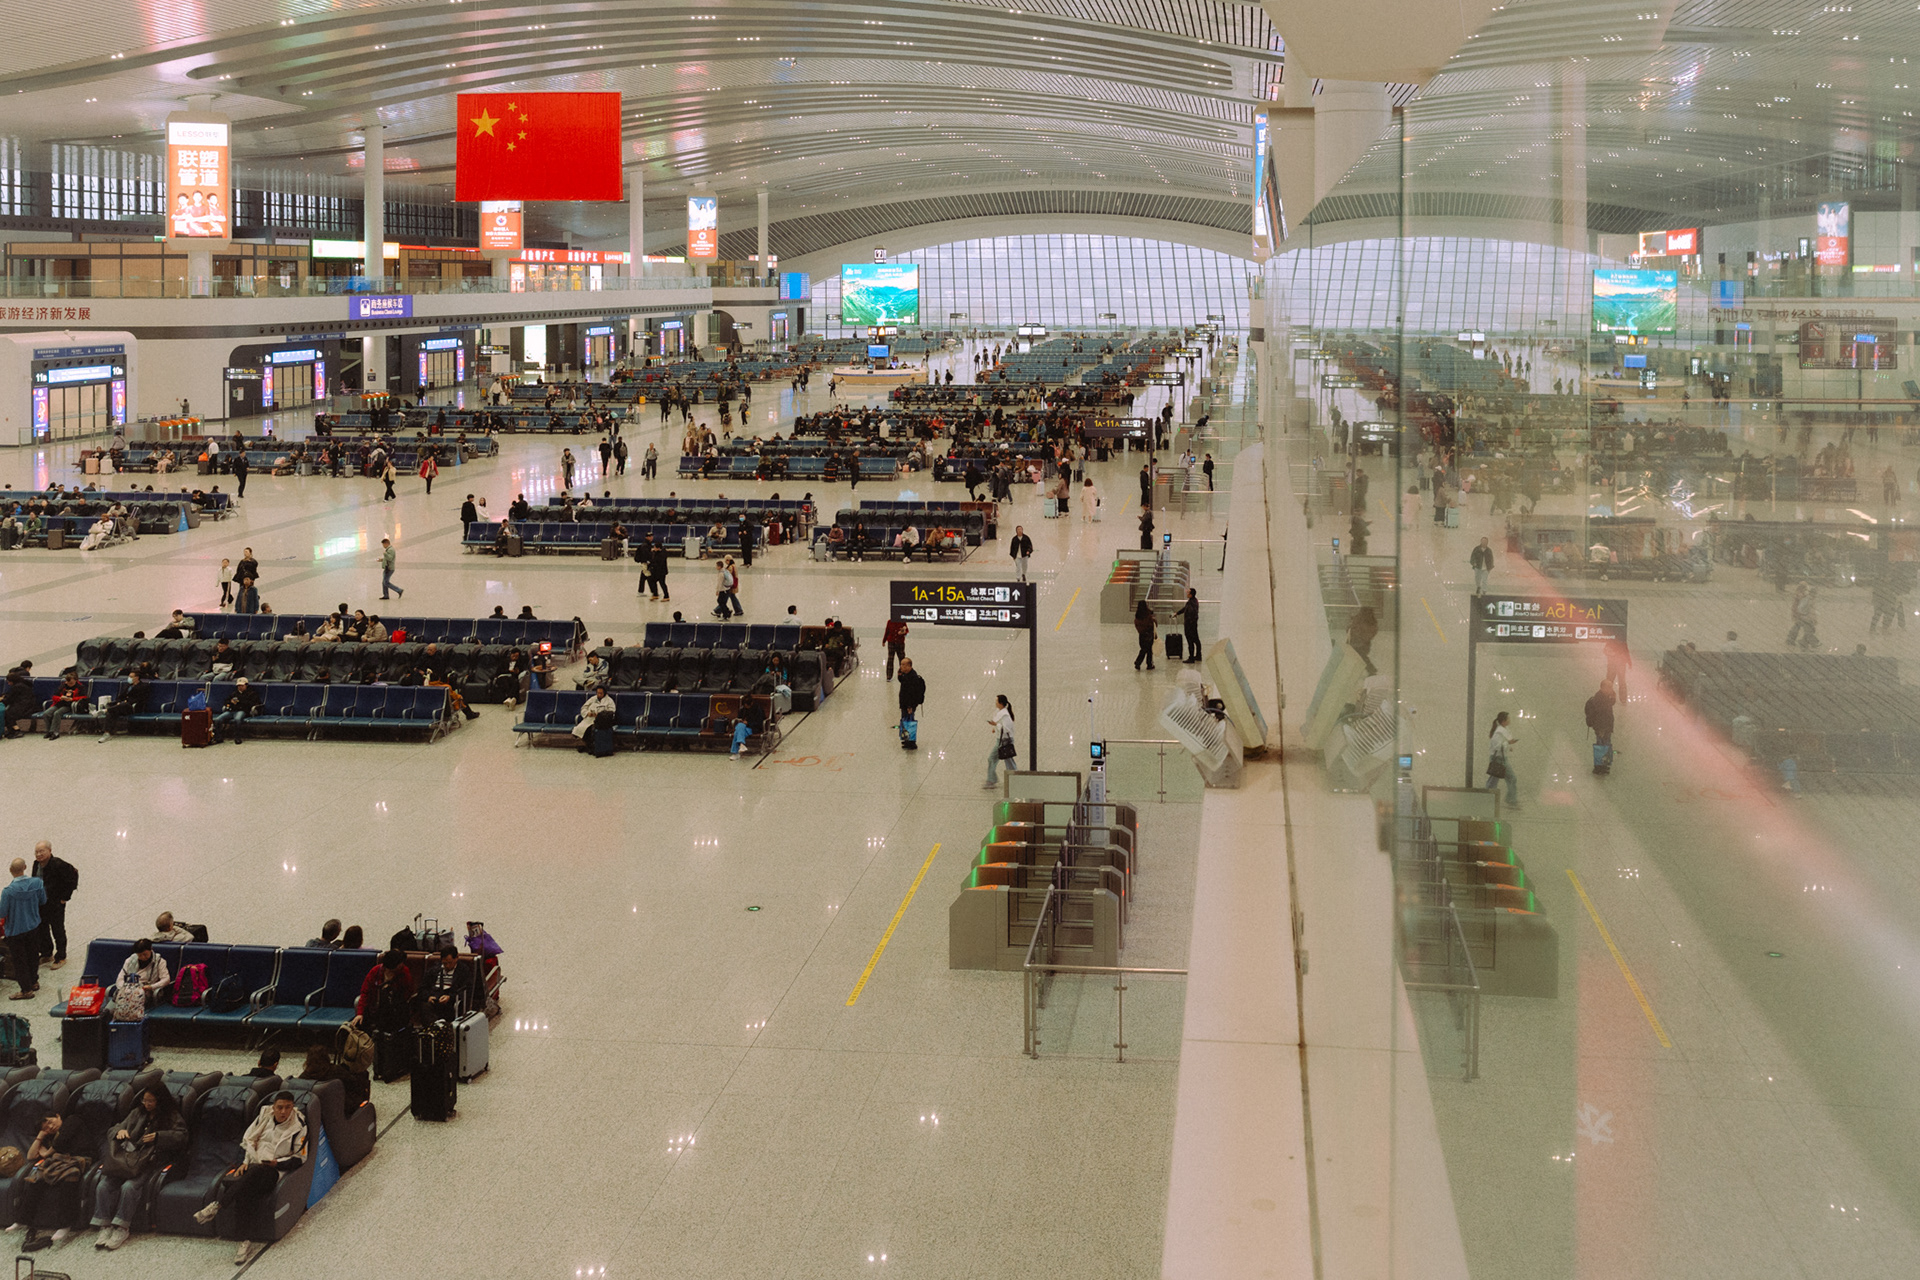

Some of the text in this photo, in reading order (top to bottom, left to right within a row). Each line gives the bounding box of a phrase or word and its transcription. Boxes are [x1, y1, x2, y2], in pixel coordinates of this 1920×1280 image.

[177, 149, 219, 168] 联塑
[177, 168, 219, 187] 管道
[1094, 419, 1120, 428] 1A-11A
[911, 585, 966, 602] 1A-15A
[970, 587, 995, 596] 检票口
